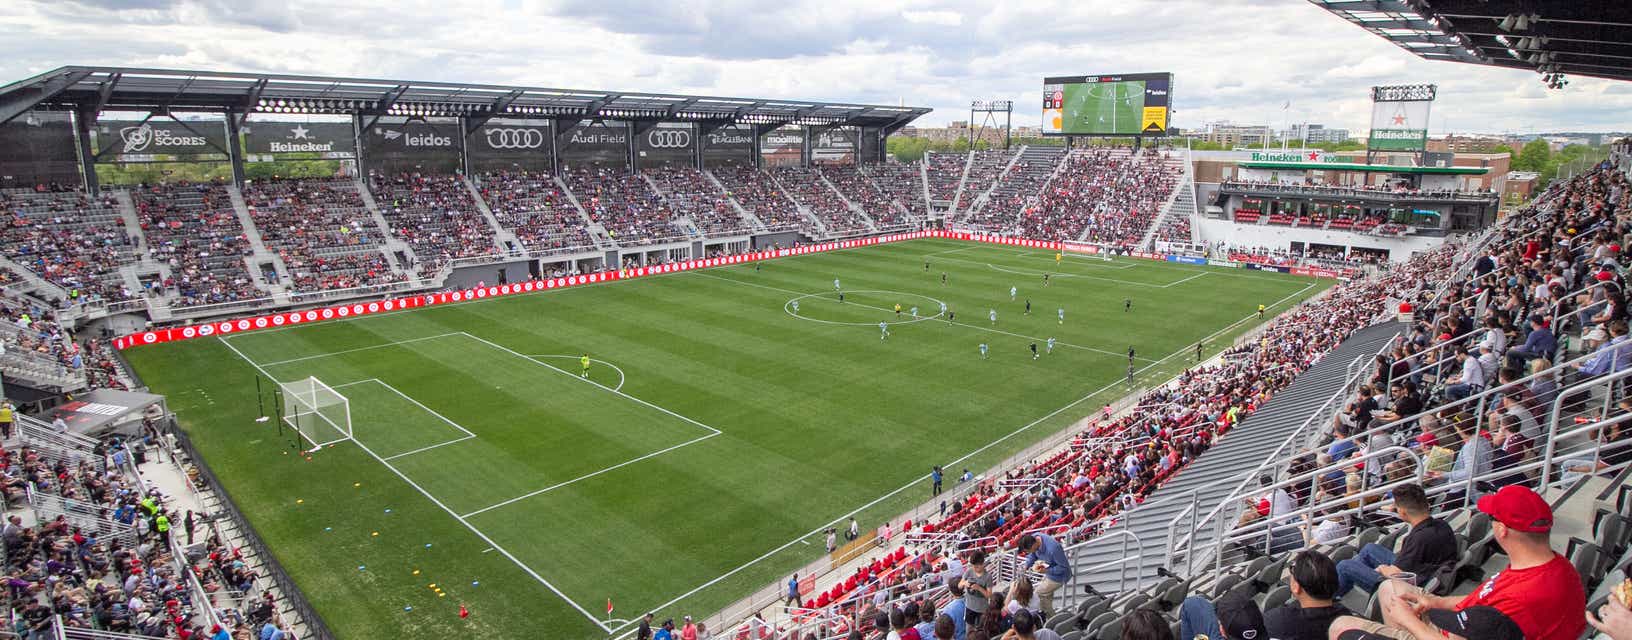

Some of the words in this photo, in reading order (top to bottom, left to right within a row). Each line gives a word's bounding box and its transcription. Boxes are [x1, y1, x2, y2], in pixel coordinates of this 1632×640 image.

[155, 129, 170, 137] DC
[1375, 130, 1424, 139] Heineken
[155, 137, 206, 146] SCORES
[405, 133, 451, 146] leidos
[571, 133, 598, 144] Audi
[600, 134, 626, 144] Field
[270, 142, 331, 152] Heineken
[1252, 152, 1302, 161] Heineken
